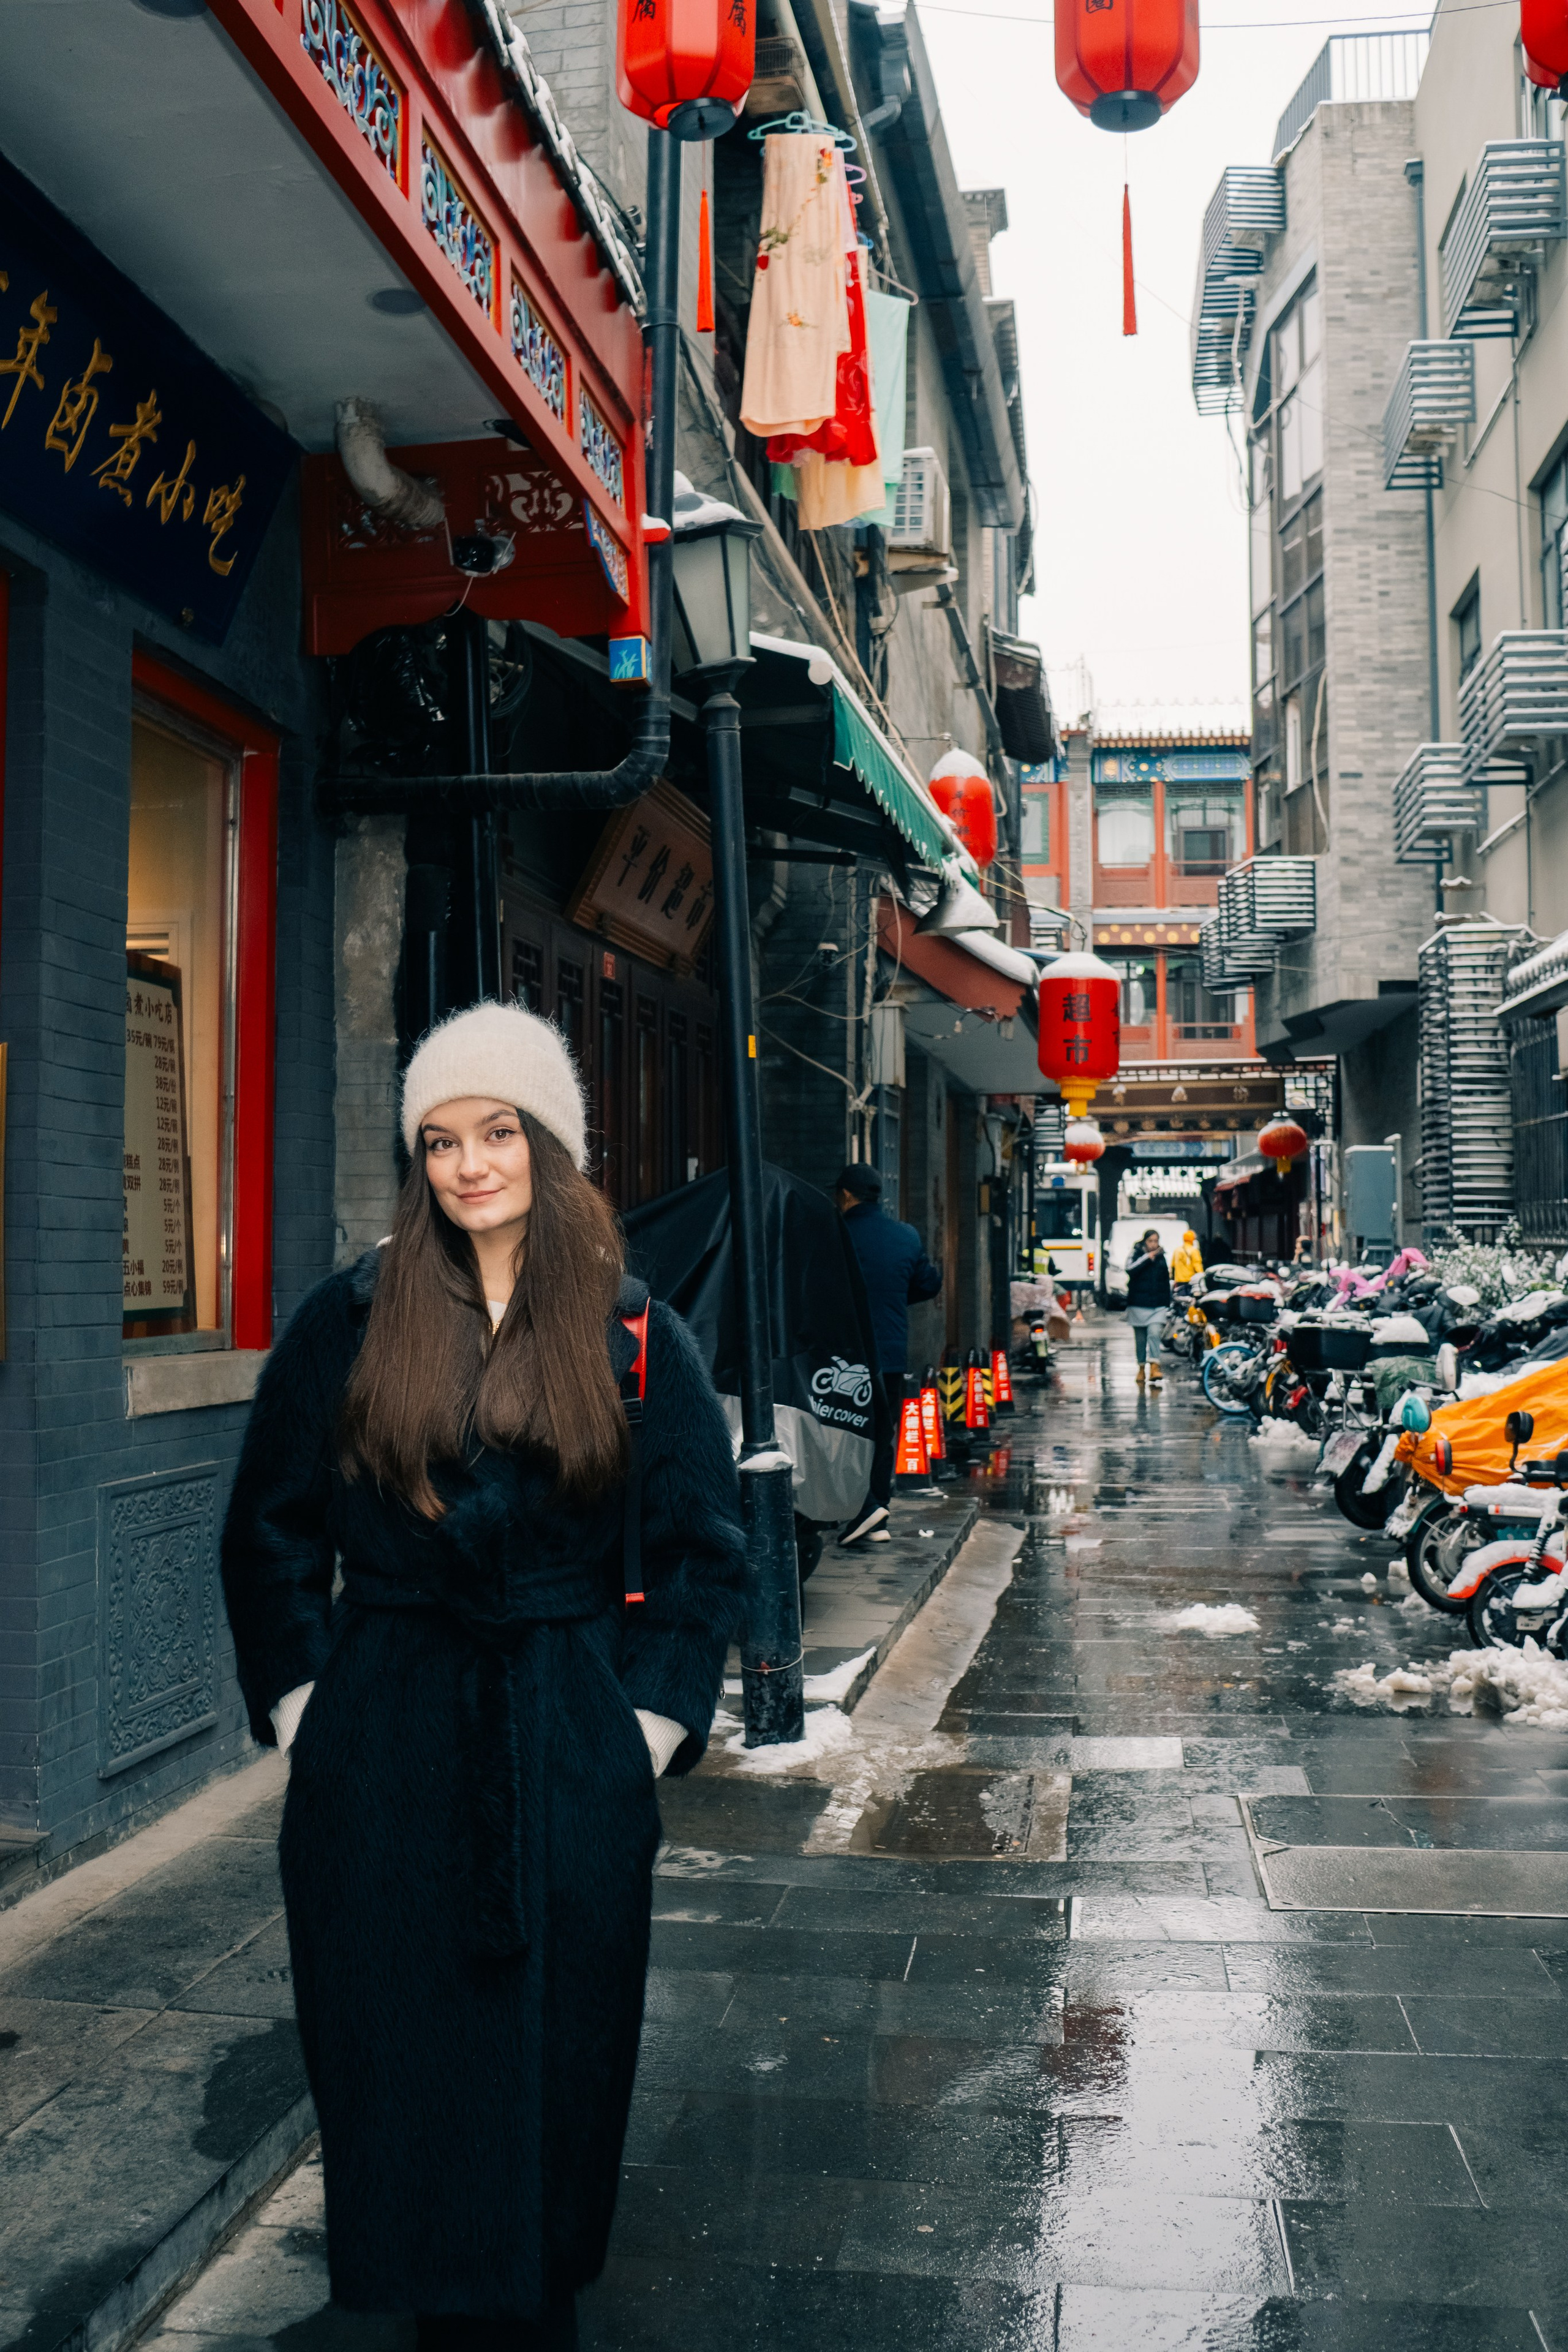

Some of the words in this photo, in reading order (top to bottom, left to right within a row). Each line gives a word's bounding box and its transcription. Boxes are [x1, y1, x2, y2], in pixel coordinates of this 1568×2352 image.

[0, 271, 246, 576] 年卤煮小吃
[1062, 993, 1092, 1065] 超市
[834, 1408, 869, 1427] cover
[905, 1401, 920, 1472] 大栅栏一百
